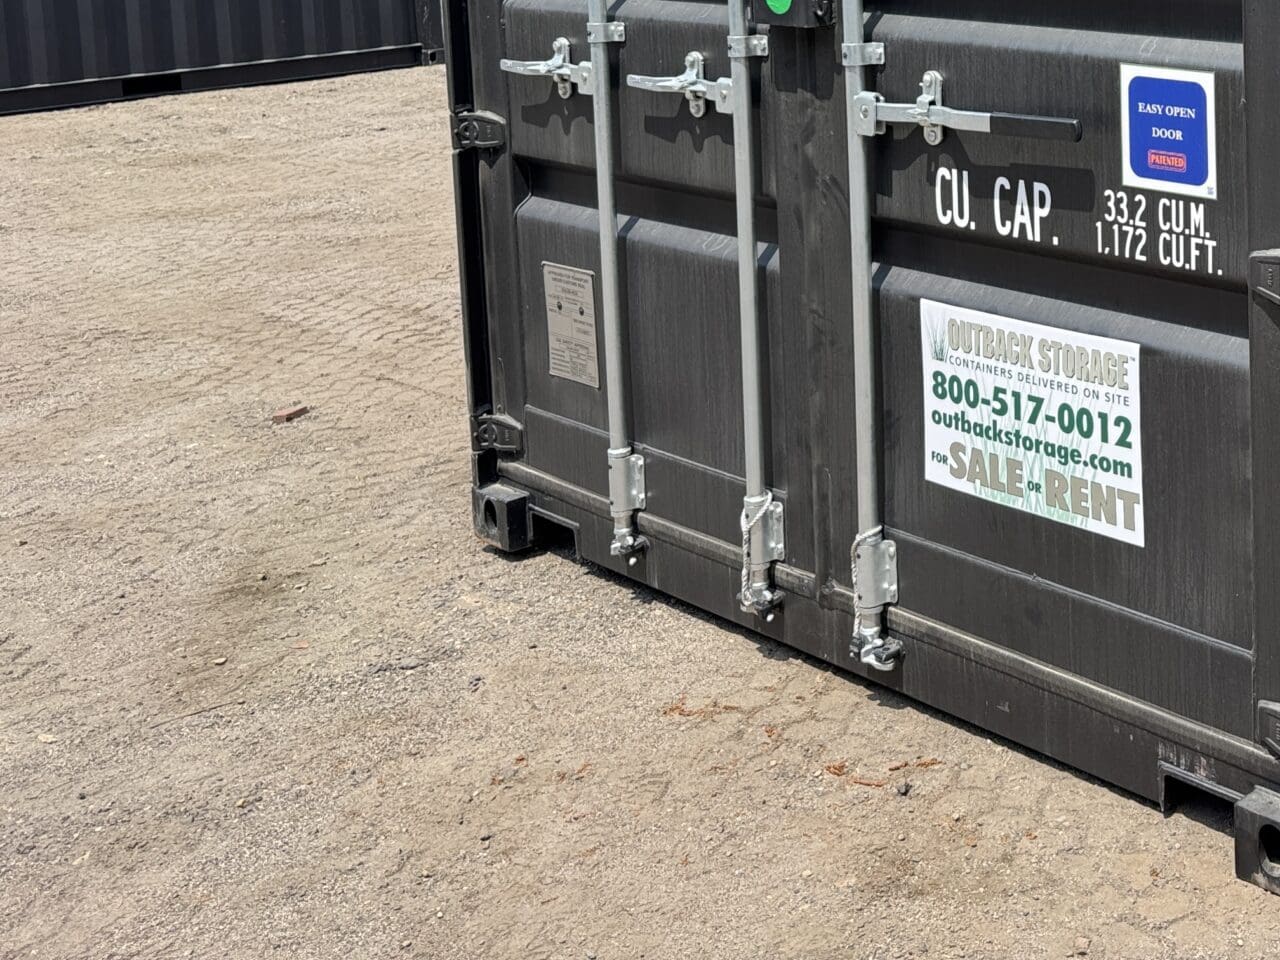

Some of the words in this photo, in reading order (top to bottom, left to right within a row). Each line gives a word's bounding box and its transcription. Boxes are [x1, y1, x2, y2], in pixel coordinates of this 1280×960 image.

[1138, 102, 1164, 115] EASY
[1165, 105, 1196, 119] OPEN
[1151, 126, 1183, 141] DOOR
[1150, 153, 1185, 168] PATENTED
[935, 166, 976, 230] CU.
[993, 176, 1059, 245] CAP.
[1103, 189, 1147, 228] 33.2
[1157, 198, 1211, 238] CU.M.
[1096, 221, 1147, 261] 1,172
[1158, 234, 1223, 275] CU.FT.
[947, 318, 1035, 370] OUTBACK
[1038, 337, 1130, 391] STORAGE
[949, 355, 1013, 379] CONTAINERS
[1017, 371, 1079, 396] DELIVERED
[1083, 387, 1100, 401] ON
[1104, 392, 1130, 407] SITE
[932, 370, 1133, 449] 800-517-0012
[931, 409, 1133, 479] outbackstorage.com
[931, 450, 948, 466] FOR
[949, 441, 1025, 498] SALE
[1027, 480, 1042, 494] OR
[1044, 468, 1141, 532] RENT
